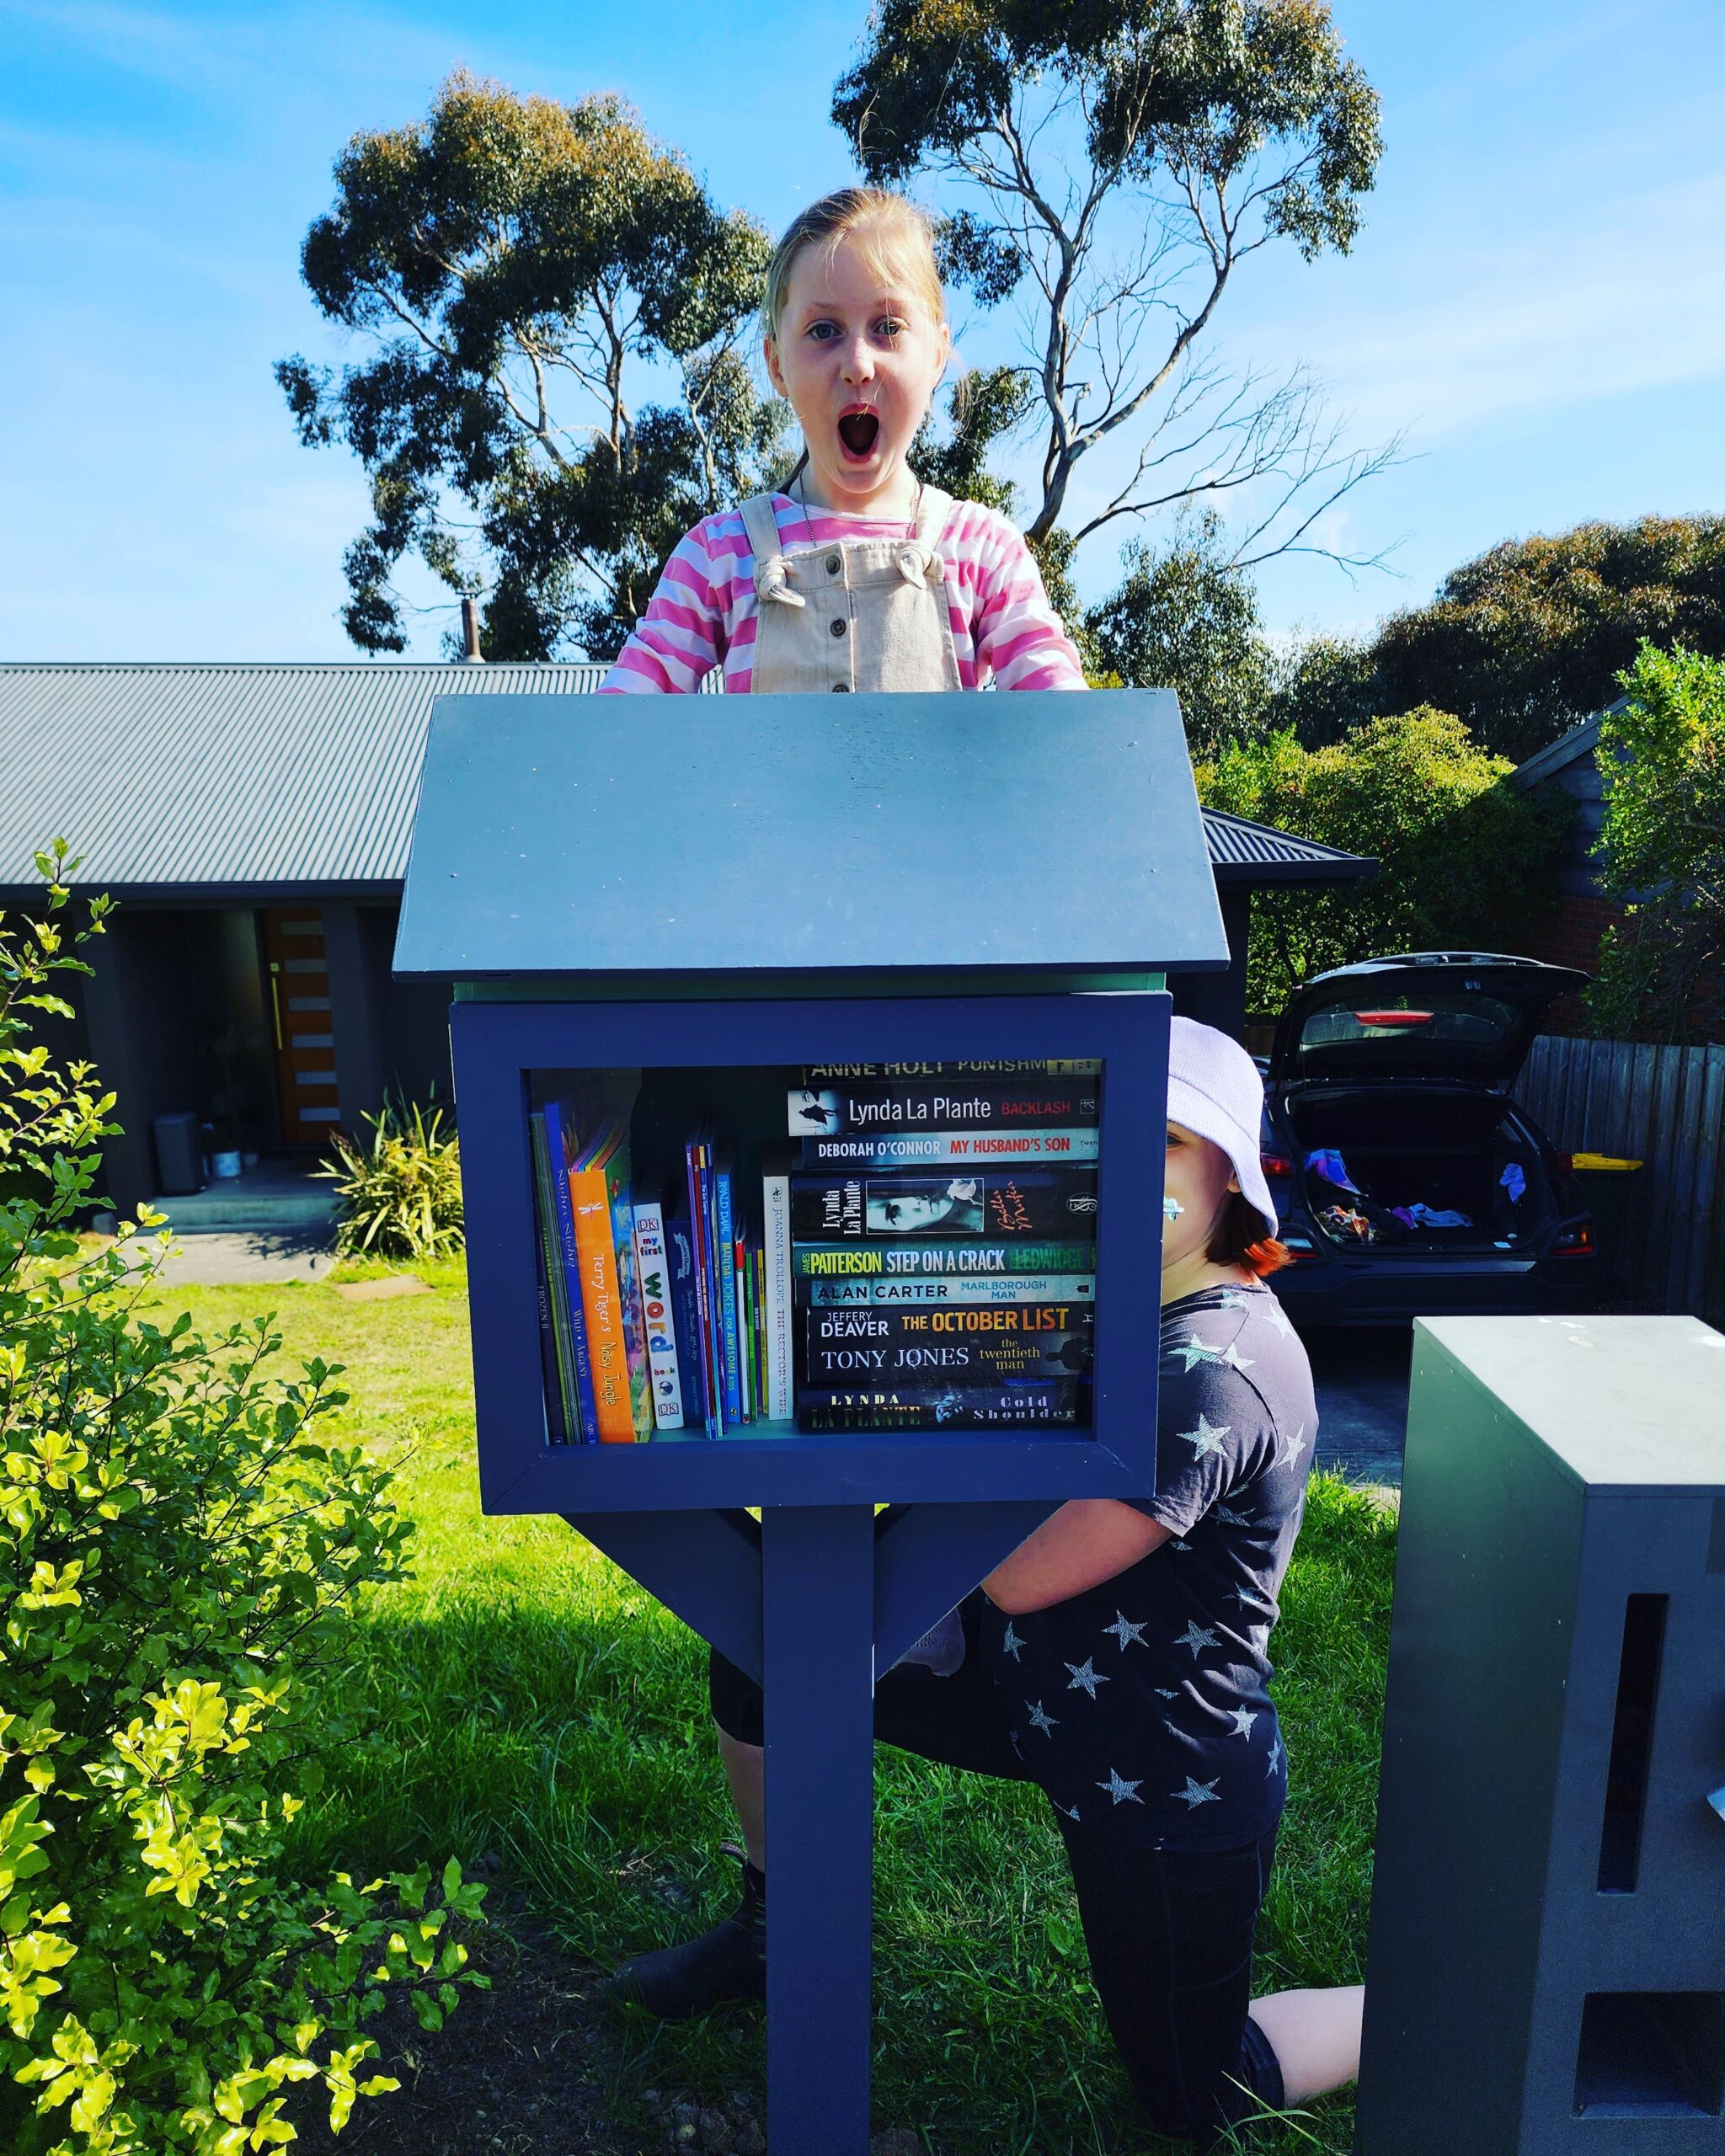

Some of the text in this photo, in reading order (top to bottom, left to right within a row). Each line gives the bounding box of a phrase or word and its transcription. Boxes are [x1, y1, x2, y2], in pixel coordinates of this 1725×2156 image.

[850, 1097, 991, 1126] Lynda La Plante
[1001, 1101, 1071, 1115] BACKLASH
[819, 1140, 941, 1157] DEBORAH O'CONNOR
[950, 1137, 1071, 1154] MY HUSBAND'S SON
[718, 1181, 729, 1209] ROALD
[822, 1190, 844, 1229] Lynda
[843, 1181, 861, 1235] La Plante
[638, 1218, 658, 1231] DK
[720, 1211, 730, 1235] DAHL
[772, 1208, 783, 1249] JOANNA
[642, 1237, 658, 1246] my
[640, 1245, 662, 1256] first
[810, 1251, 883, 1275] PATTERSON
[886, 1249, 1006, 1273] STEP ON A CRACK
[776, 1251, 785, 1304] TROLLOPE
[961, 1280, 1047, 1291] MARLBOROUGH
[723, 1281, 734, 1315] JOKES
[818, 1285, 948, 1299] ALAN CARTER
[991, 1290, 1016, 1299] MAN
[537, 1285, 548, 1320] FROZEN
[644, 1272, 674, 1353] word
[827, 1311, 873, 1322] JEFFERY
[902, 1308, 1070, 1332] THE OCTOBER LIST
[591, 1252, 623, 1406] Terry Tiger's Noisy Jungle
[821, 1321, 889, 1337] DEAVER
[574, 1309, 588, 1379] WILD ARGENT
[1001, 1338, 1018, 1348] the
[726, 1332, 736, 1374] AWESOME
[778, 1332, 787, 1386] RECTOR'S
[821, 1348, 969, 1369] TONY JONES
[980, 1347, 1040, 1359] twentieth
[654, 1367, 676, 1375] book
[996, 1360, 1024, 1371] man
[831, 1394, 900, 1406] LYNDA
[1001, 1396, 1048, 1407] Cold
[659, 1402, 679, 1416] DK
[974, 1409, 1076, 1420] Shoulder
